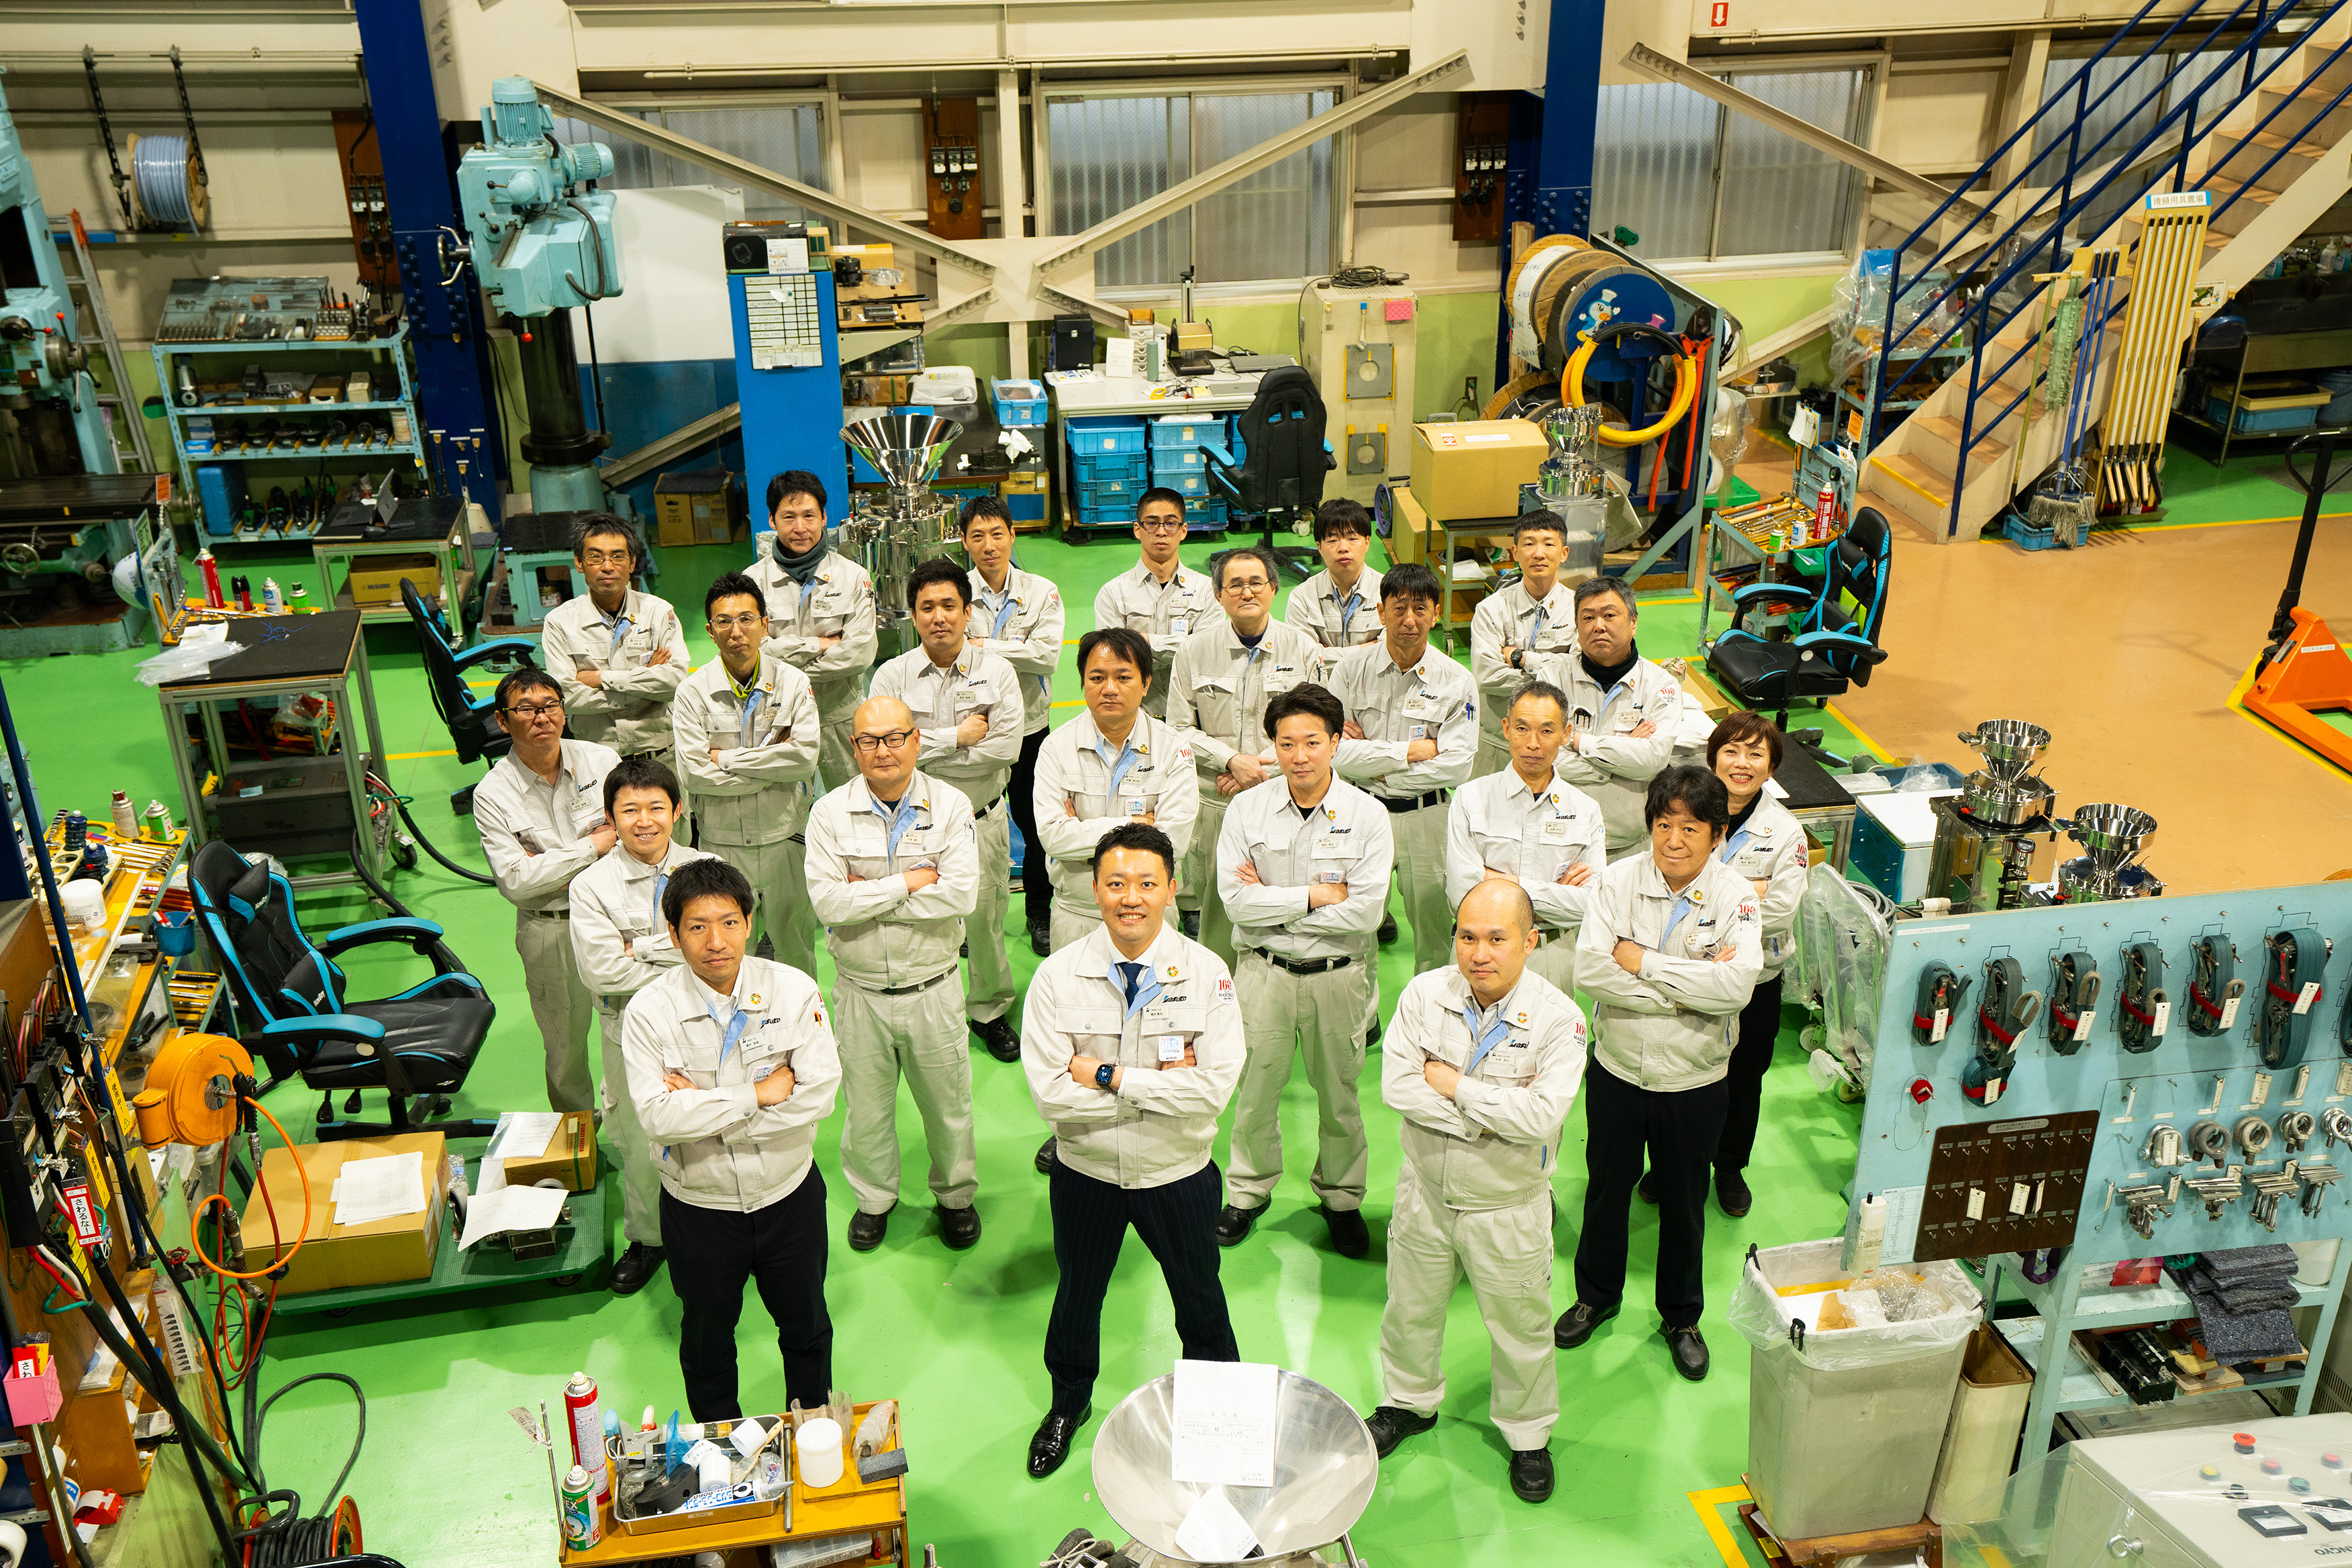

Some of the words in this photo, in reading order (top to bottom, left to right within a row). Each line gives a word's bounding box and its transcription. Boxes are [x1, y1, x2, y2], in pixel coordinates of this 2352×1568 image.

[2153, 194, 2205, 205] 清掃用具置場
[1329, 826, 1352, 834] Masuko
[1162, 995, 1187, 1004] Masuko
[1164, 1040, 1178, 1051] 6S
[75, 1197, 91, 1236] さわるな!
